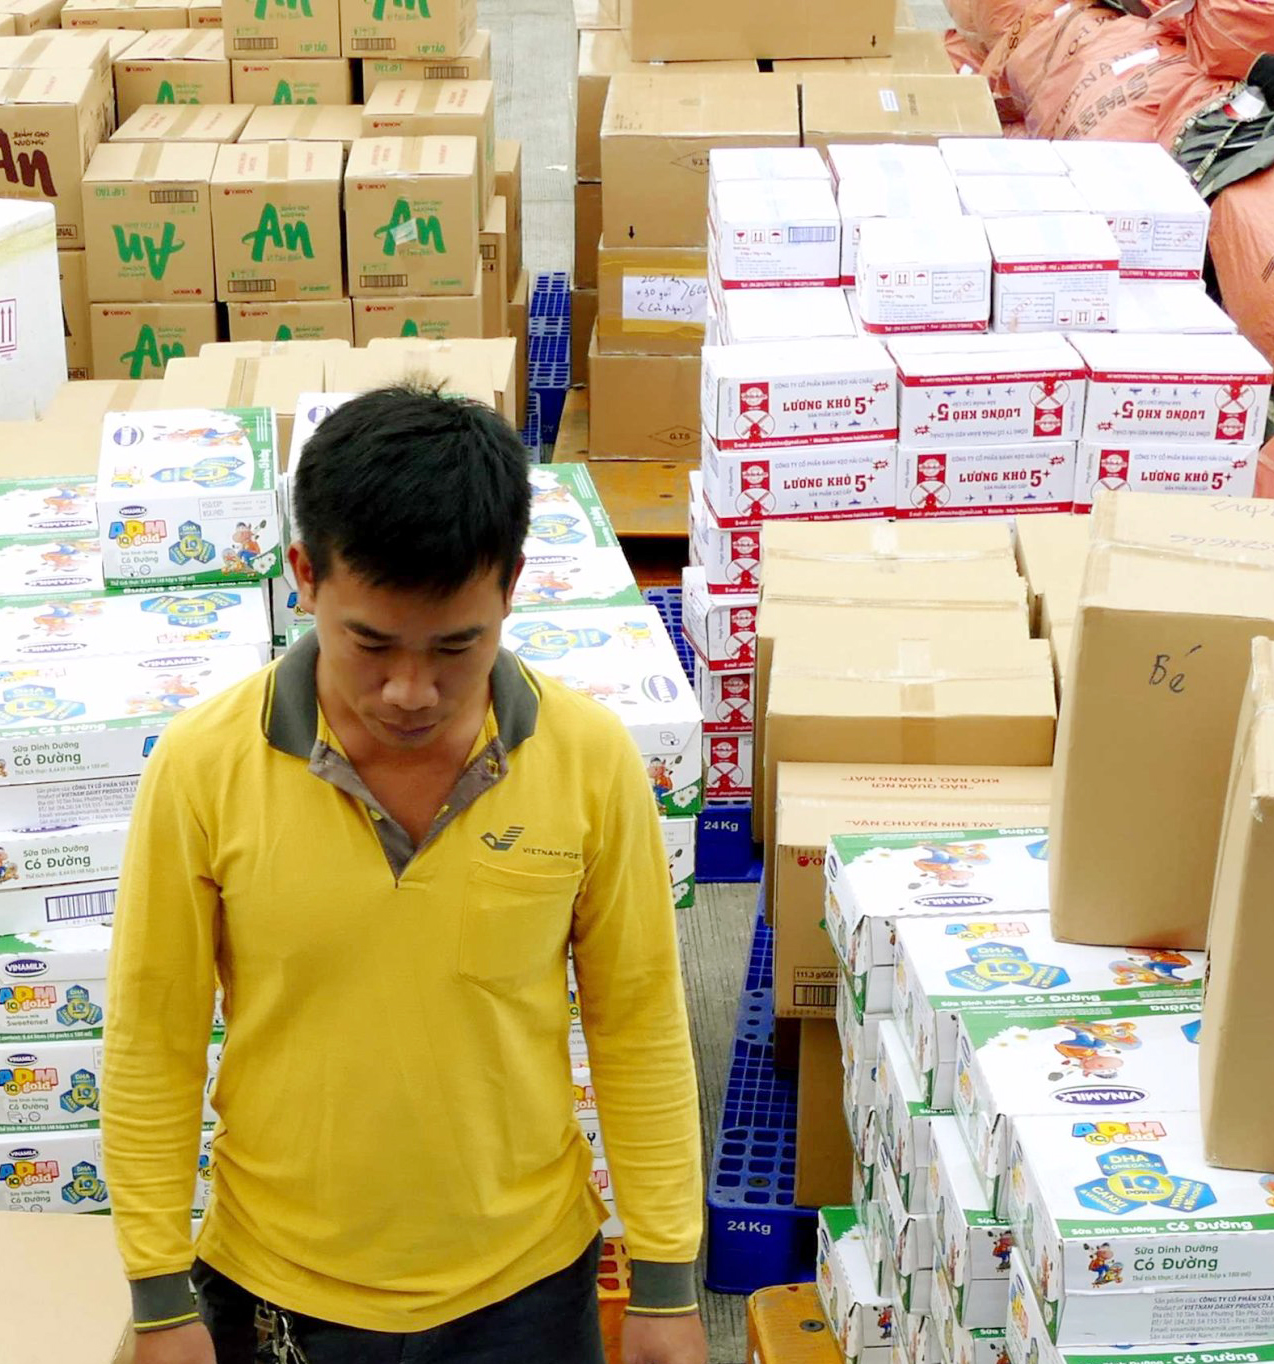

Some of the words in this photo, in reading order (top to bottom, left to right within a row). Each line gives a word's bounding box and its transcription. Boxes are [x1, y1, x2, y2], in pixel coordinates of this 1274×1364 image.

[242, 203, 314, 262] An
[374, 196, 446, 256] An
[112, 222, 185, 280] An
[783, 400, 822, 412] LƯƠNG
[827, 398, 851, 409] KHÔ
[953, 409, 977, 420] KHÔ
[982, 407, 1021, 420] LƯƠNG
[1137, 409, 1161, 420] KHÔ
[1166, 409, 1205, 421] LƯƠNG
[959, 470, 998, 483] LƯƠNG
[1003, 469, 1027, 481] KHÔ
[1141, 469, 1180, 482] LƯƠNG
[1184, 471, 1209, 482] KHÔ
[784, 478, 822, 490] LƯƠNG
[827, 476, 851, 486] KHÔ
[13, 745, 28, 753] Sữa
[31, 743, 50, 751] Dinh
[52, 741, 79, 750] Dưỡng
[14, 753, 31, 766] Có
[36, 752, 81, 765] Đường
[23, 850, 39, 858] Sữa
[41, 848, 60, 856] Dinh
[63, 844, 89, 854] Dưỡng
[522, 847, 560, 857] VIETNAM
[25, 858, 41, 871] Có
[47, 856, 91, 870] Đường
[917, 896, 991, 907] VINAMILK
[6, 961, 46, 973] VINAMILK
[23, 999, 50, 1013] gold
[22, 1081, 52, 1094] gold
[1056, 1092, 1145, 1104] VINAMILK
[1109, 1154, 1150, 1163] DHA
[24, 1173, 53, 1186] gold
[1071, 1227, 1093, 1235] Sữa
[1122, 1225, 1156, 1234] Dưỡng
[1166, 1220, 1190, 1231] Có
[1194, 1220, 1253, 1230] Đường
[1134, 1245, 1154, 1256] Sữa
[1158, 1245, 1181, 1254] Dinh
[1185, 1244, 1218, 1254] Dưỡng
[1134, 1257, 1155, 1271] Có
[1162, 1256, 1218, 1271] Đường
[1202, 1350, 1258, 1364] Đường
